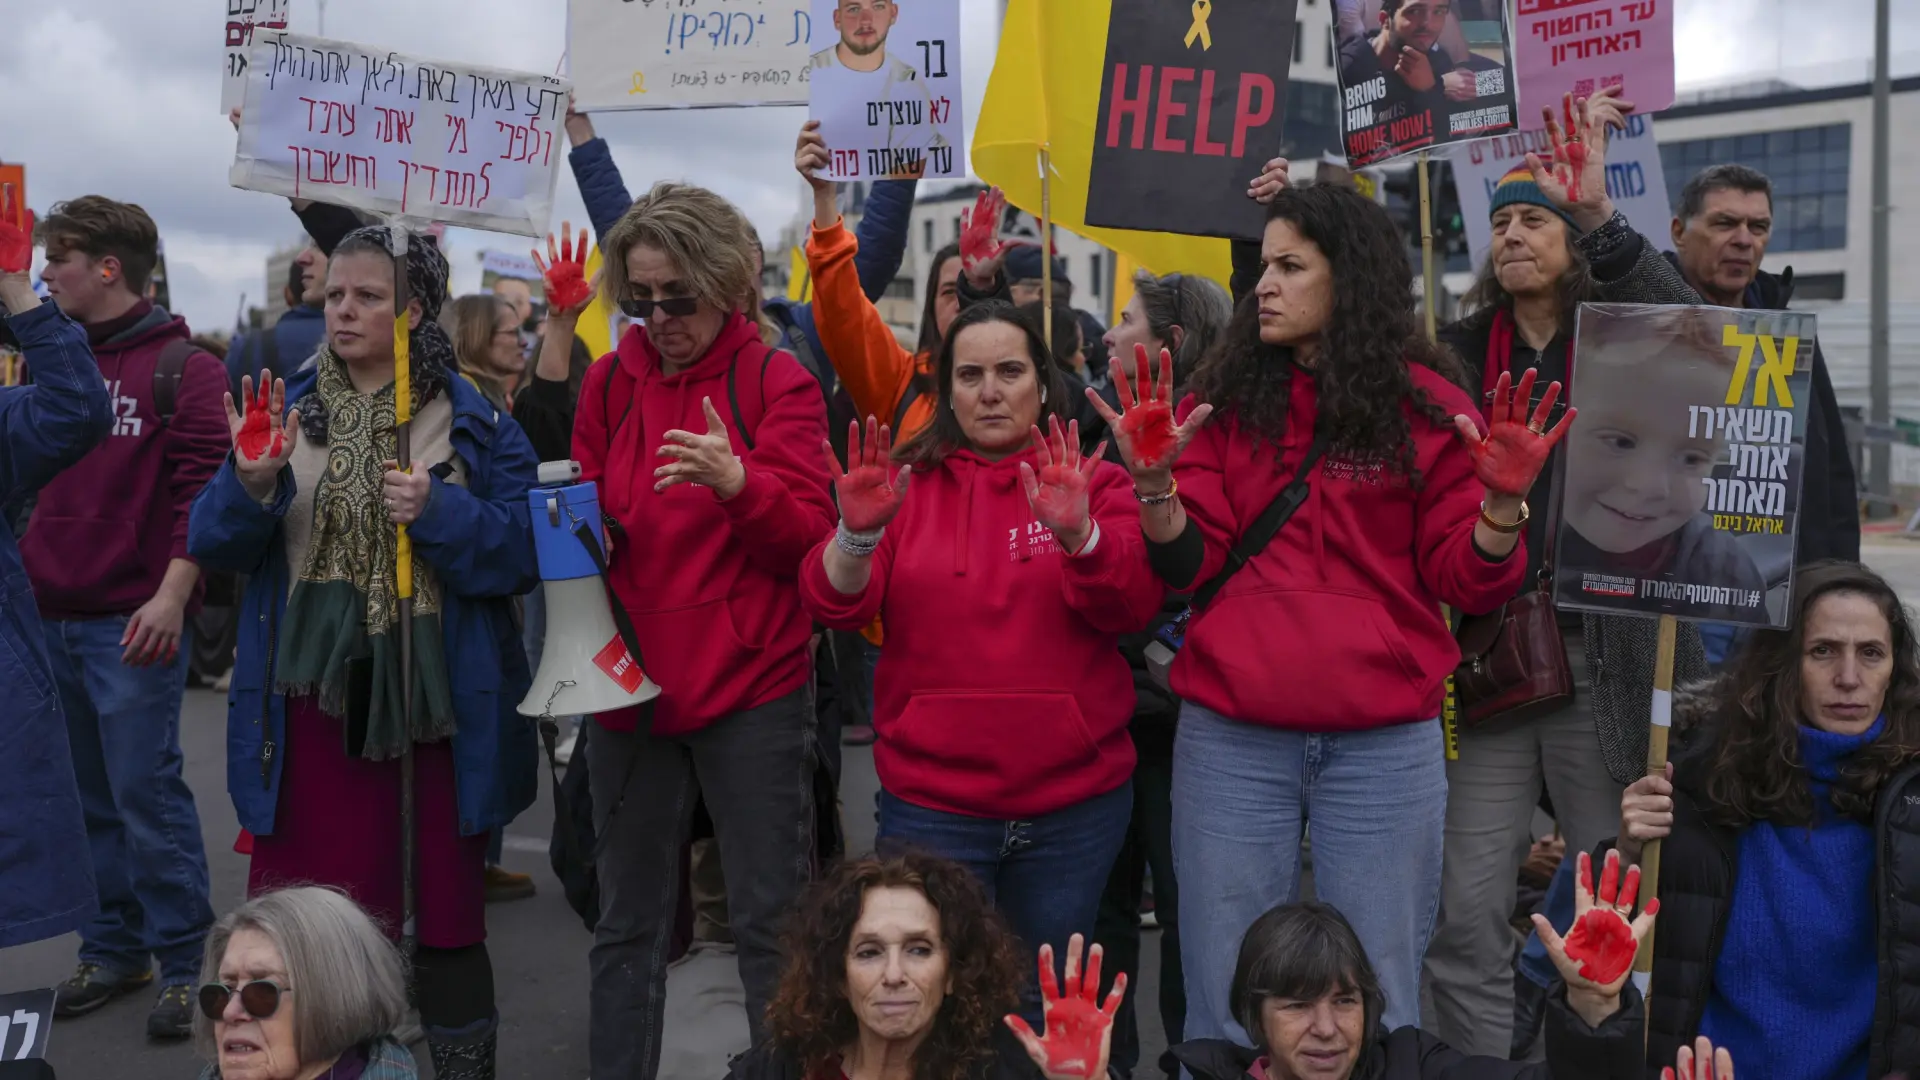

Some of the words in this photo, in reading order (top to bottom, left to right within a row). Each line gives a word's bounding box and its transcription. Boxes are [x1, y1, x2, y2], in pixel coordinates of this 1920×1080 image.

[1532, 8, 1613, 42] החטוף
[1620, 0, 1656, 22] עד
[1551, 30, 1641, 66] האחרון
[310, 49, 350, 85] אתה
[468, 74, 515, 119] מאין
[525, 86, 564, 120] דע
[930, 96, 951, 124] לא
[1105, 62, 1276, 158] HELP
[1345, 76, 1387, 110] BRING
[299, 96, 355, 137] עתיד
[374, 106, 414, 144] אתה
[867, 100, 922, 126] עוצרים
[1347, 104, 1373, 132] HIM
[1450, 117, 1482, 132] FAMILIES
[1483, 112, 1510, 127] FORUM
[445, 114, 468, 153] מי
[495, 117, 552, 166] ולפני
[1348, 124, 1387, 157] HOME
[287, 145, 376, 198] וחשבון
[829, 149, 860, 177] פה!
[868, 147, 920, 176] שאתה
[928, 147, 952, 174] עד
[1722, 324, 1799, 408] אל
[1688, 405, 1793, 444] תשאירו
[1728, 443, 1791, 480] אותי
[1702, 477, 1786, 516] מאחור
[1713, 514, 1742, 531] ביבס
[1745, 515, 1784, 534] אריאל
